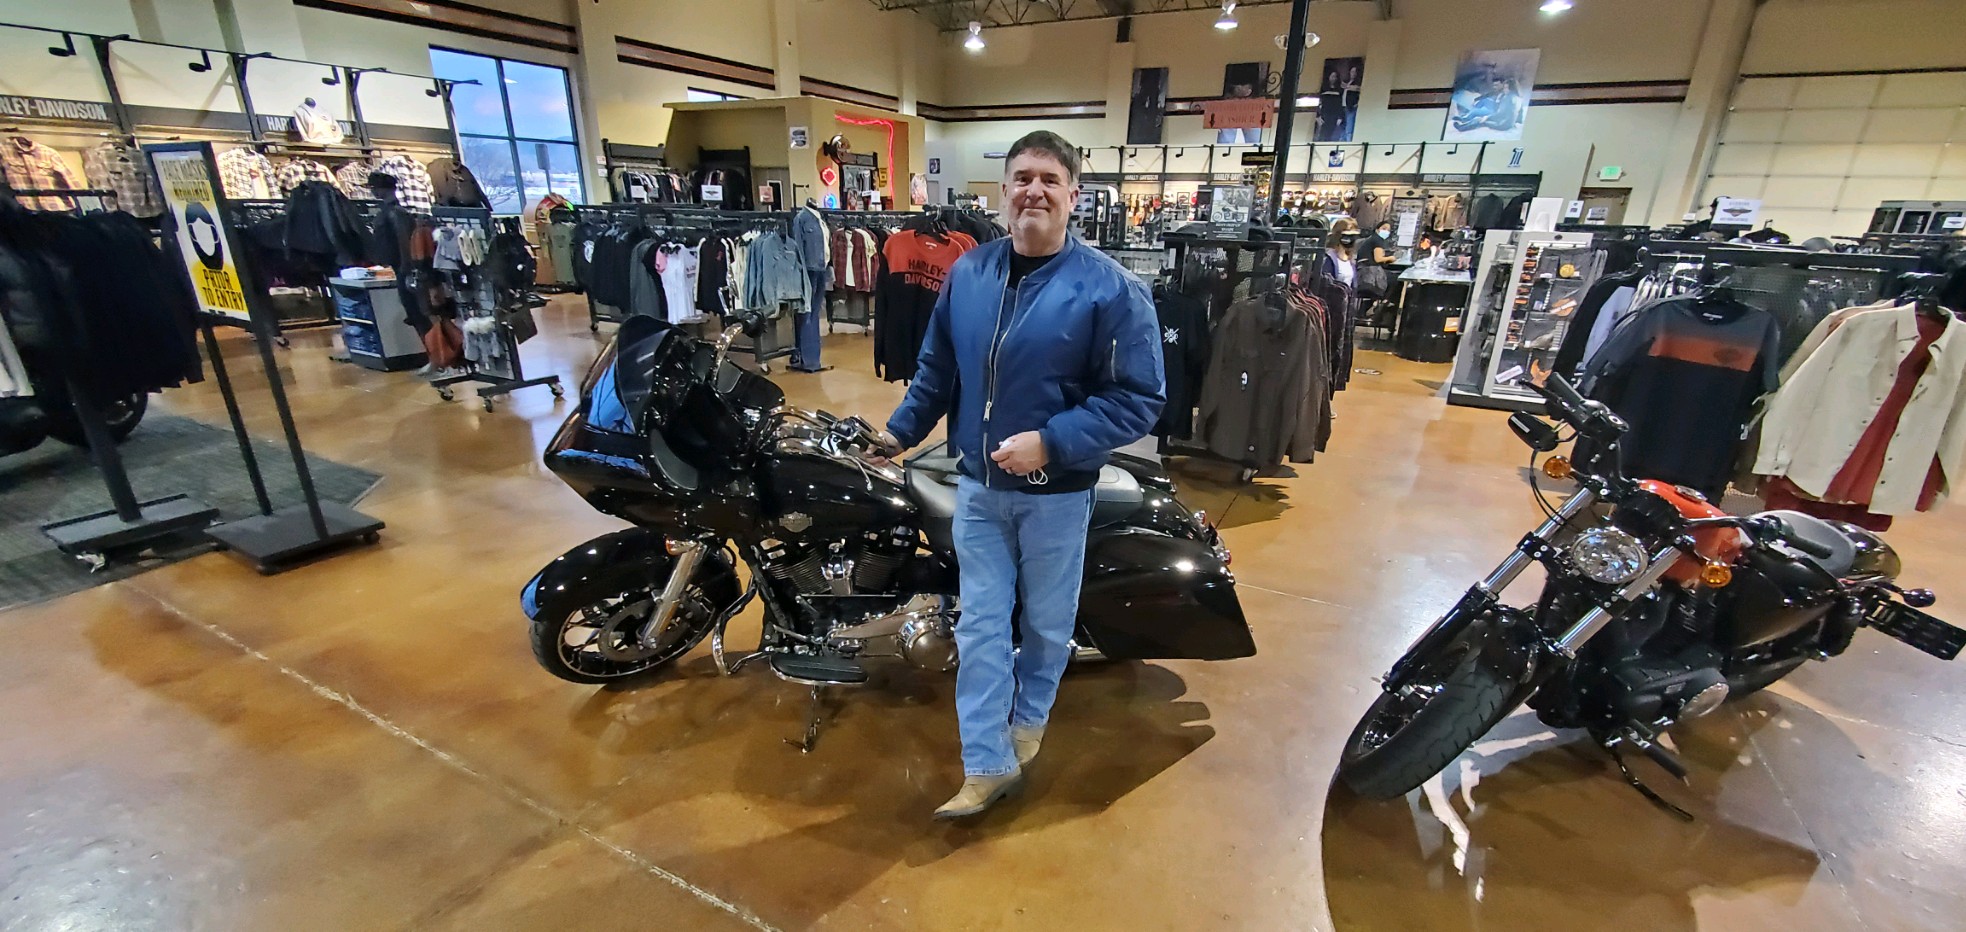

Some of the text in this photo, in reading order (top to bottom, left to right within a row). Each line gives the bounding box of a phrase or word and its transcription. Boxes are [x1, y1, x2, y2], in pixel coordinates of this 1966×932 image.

[203, 269, 233, 290] PRIOR
[202, 286, 244, 311] TO ENTRY
